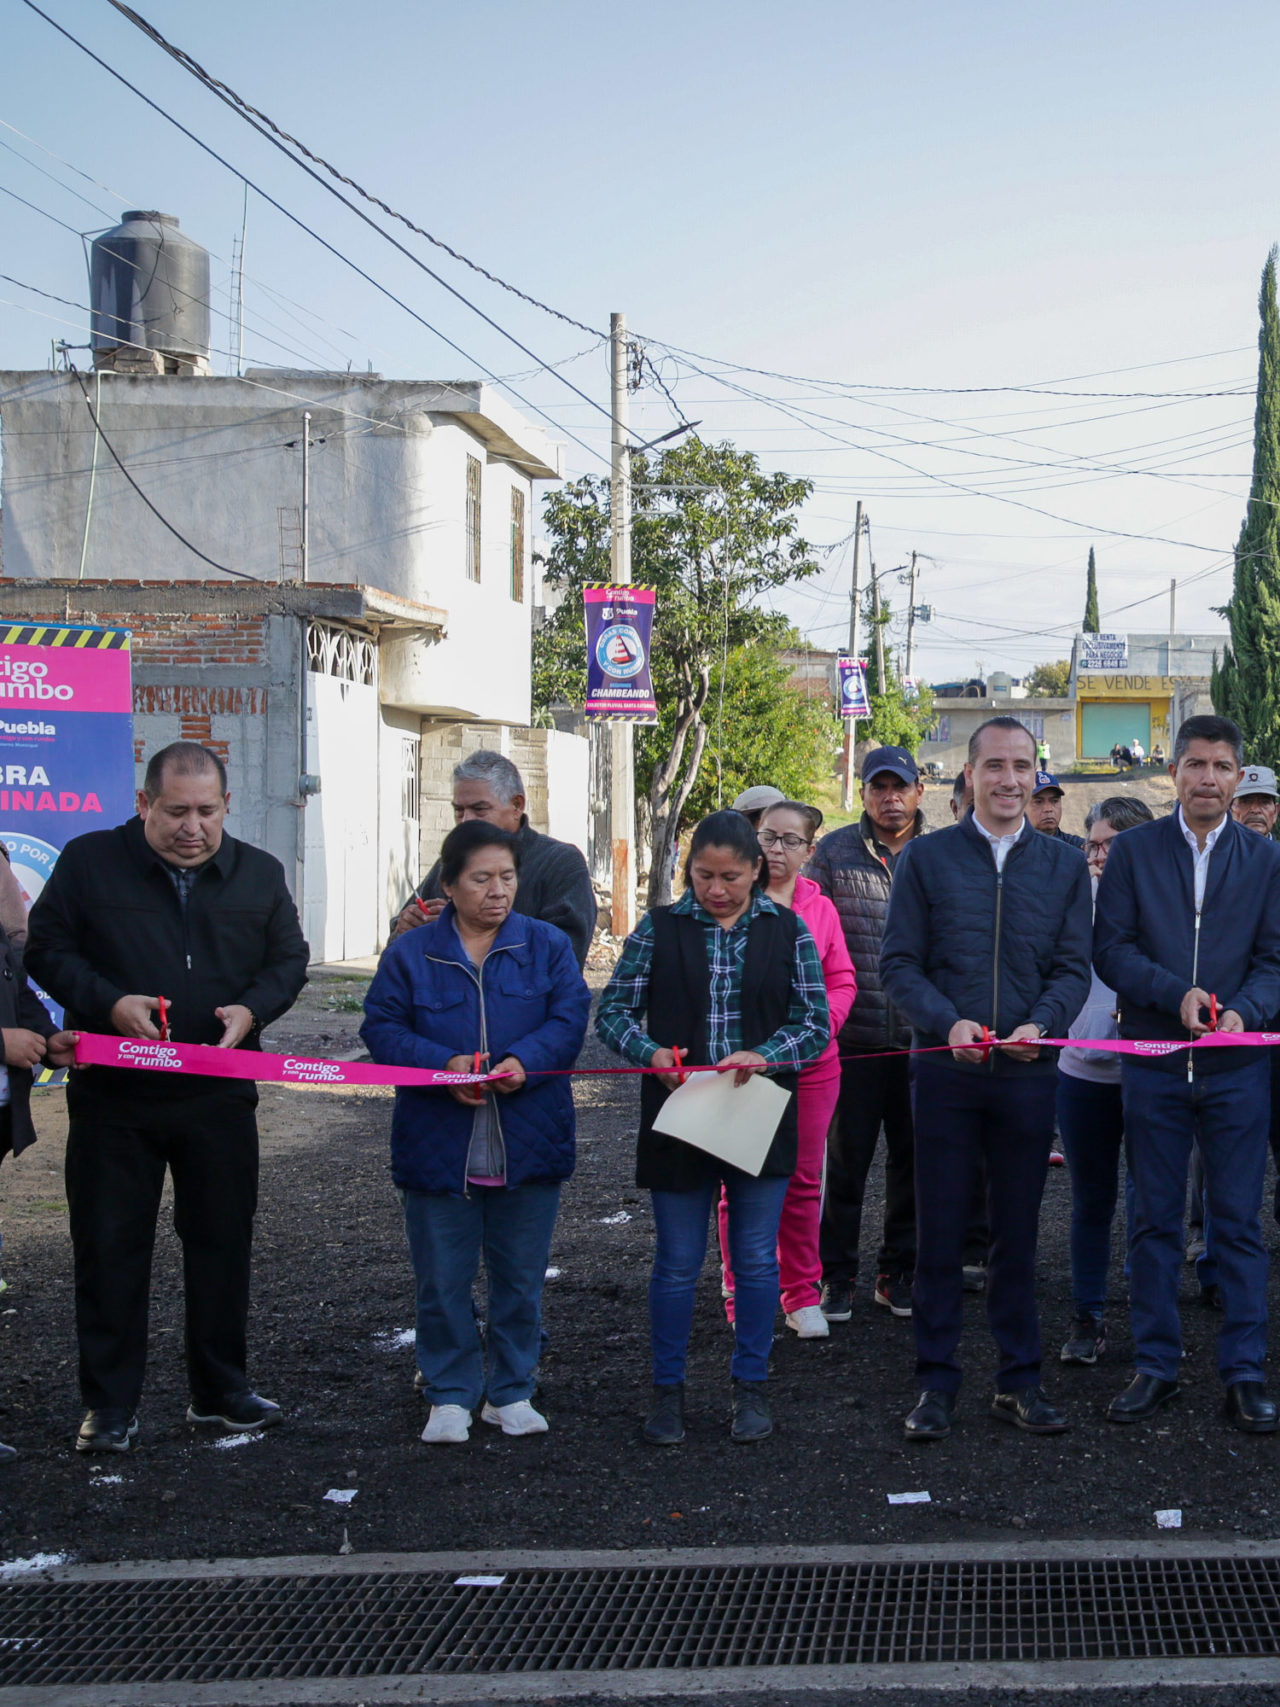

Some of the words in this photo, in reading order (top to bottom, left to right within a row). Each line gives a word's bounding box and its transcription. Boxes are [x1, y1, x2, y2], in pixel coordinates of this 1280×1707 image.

[1077, 675, 1096, 690] SE
[1104, 675, 1152, 690] VENDE
[591, 688, 650, 699] CHAMBEANDO
[0, 790, 103, 813] INADA
[20, 843, 50, 865] POR
[119, 1041, 177, 1058] Contigo
[134, 1055, 182, 1068] rumbo
[284, 1058, 340, 1074] Contigo
[298, 1071, 345, 1081] rumbo
[432, 1072, 488, 1081] Contigo
